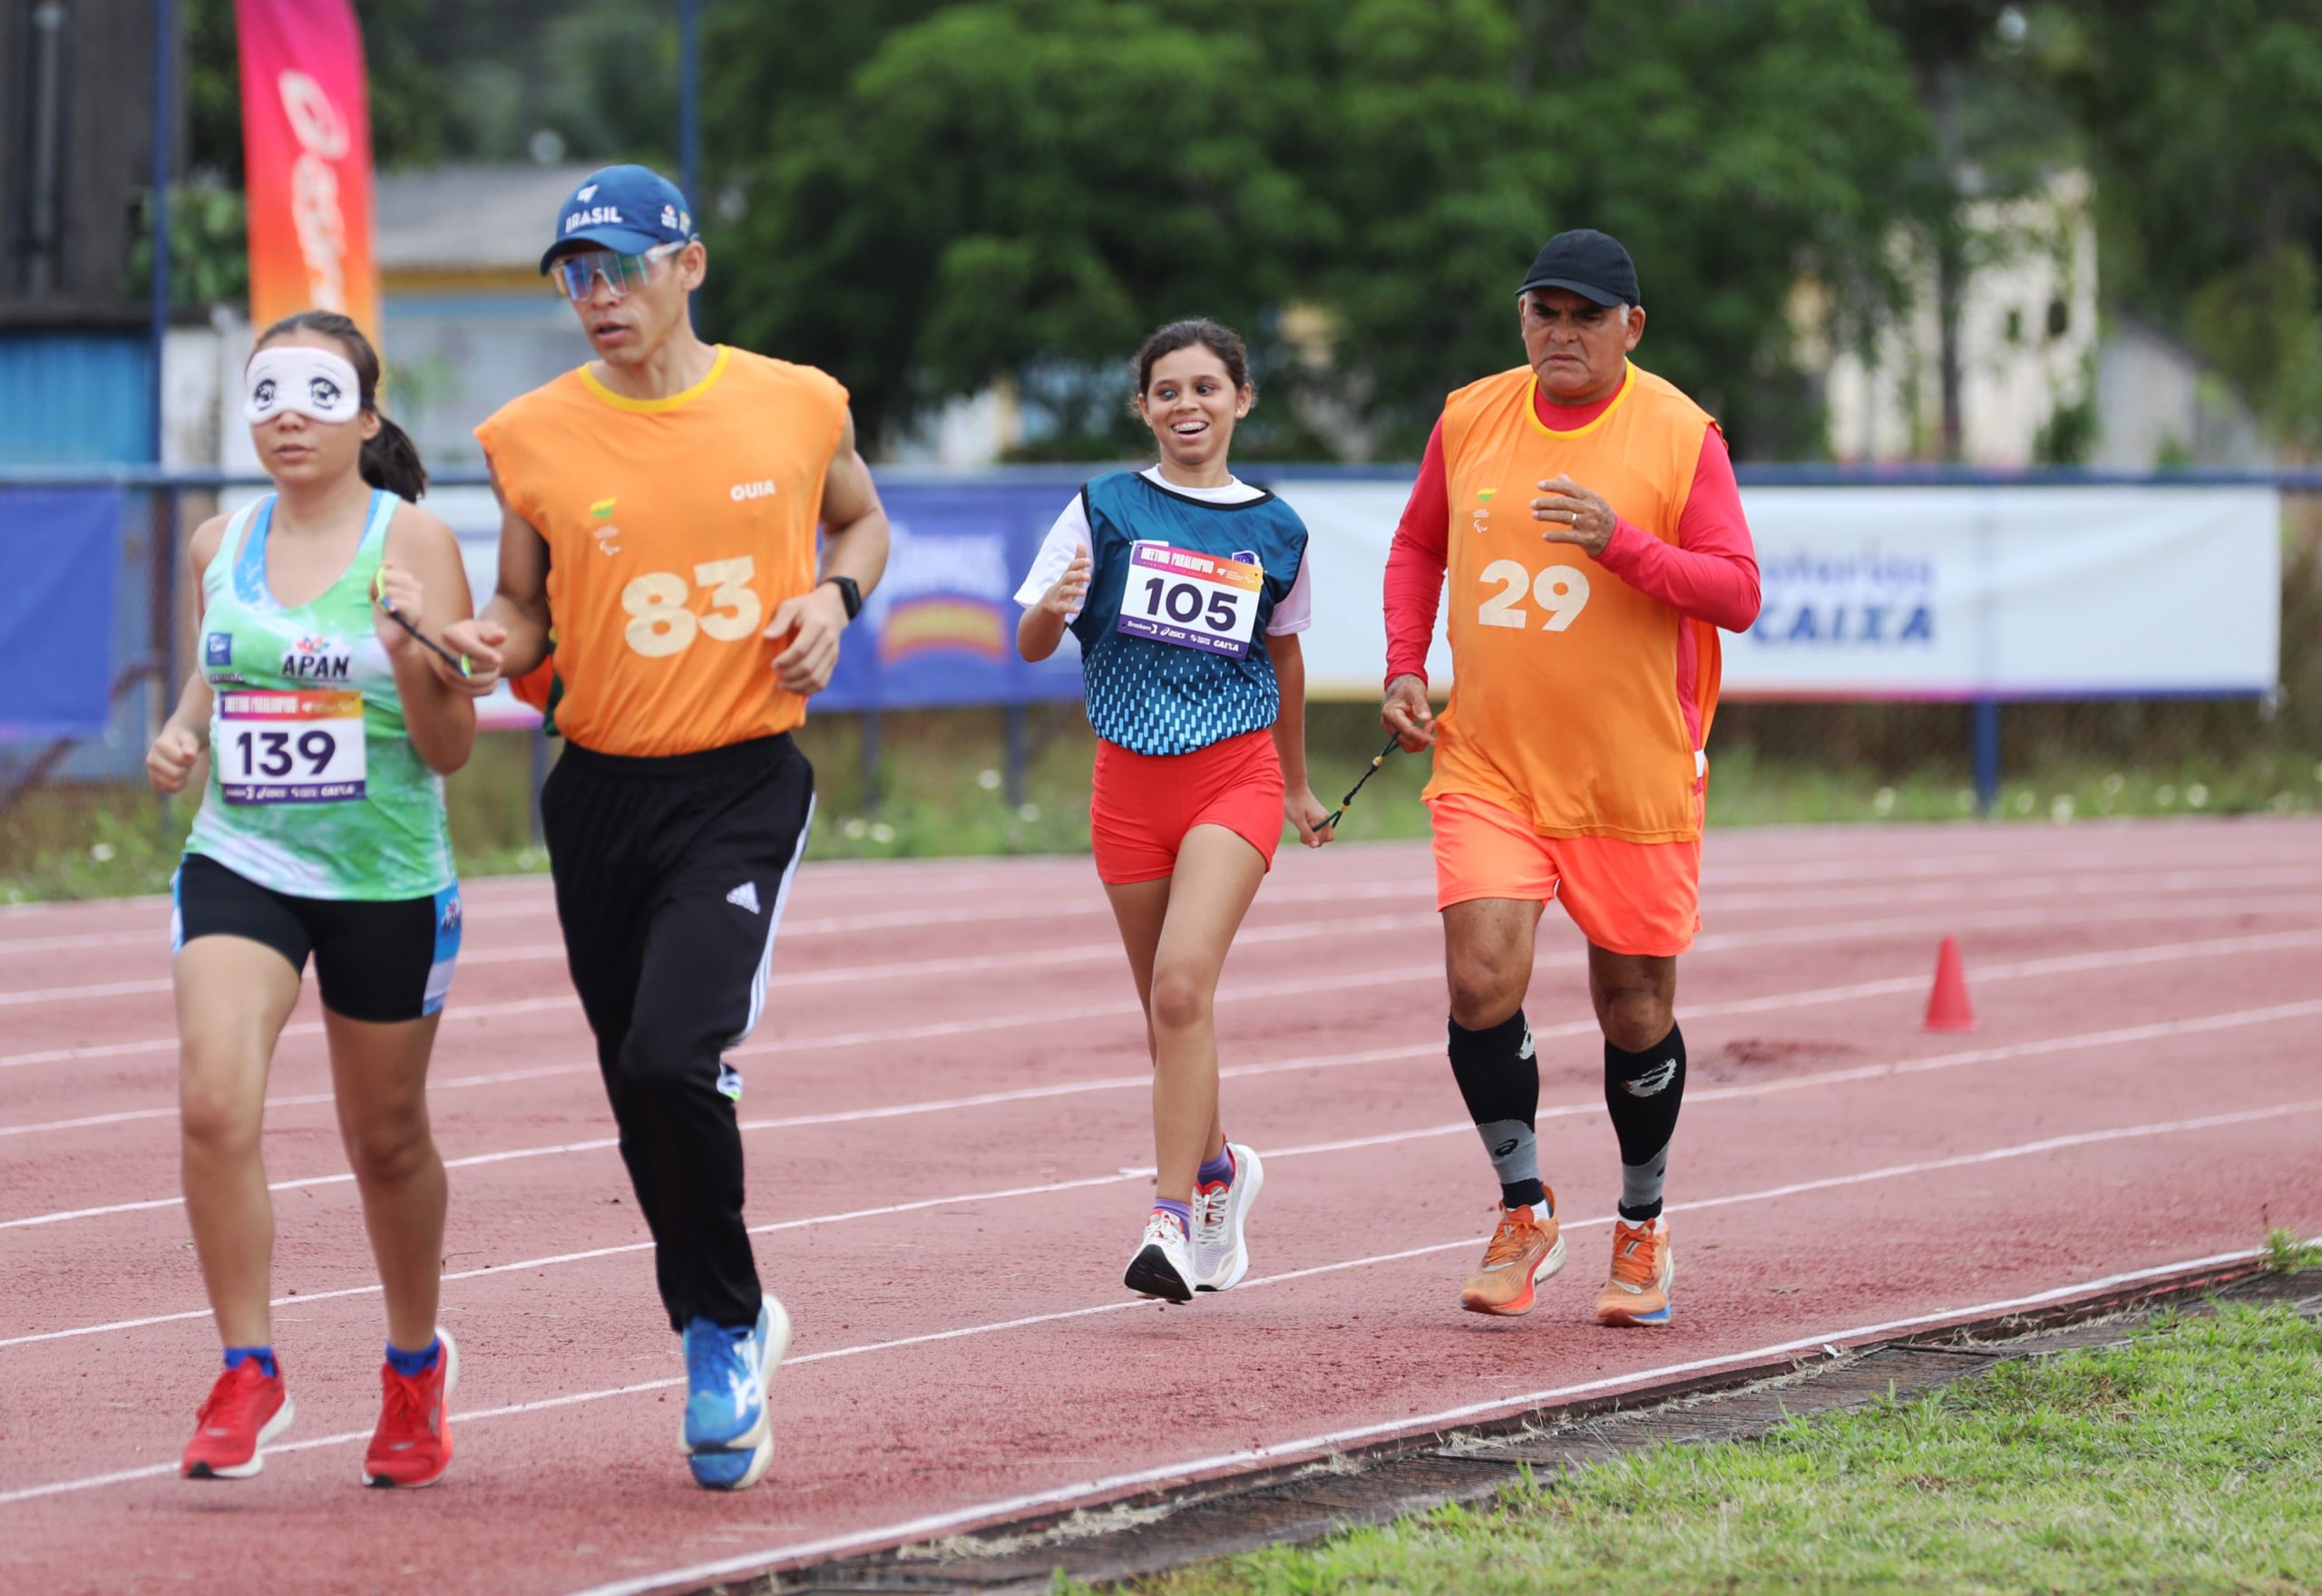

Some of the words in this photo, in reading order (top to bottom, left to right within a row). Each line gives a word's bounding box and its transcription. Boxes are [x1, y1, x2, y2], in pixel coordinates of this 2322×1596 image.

[565, 206, 623, 234] BRASIL
[730, 480, 776, 501] GUIA
[620, 555, 763, 657] 83
[1145, 578, 1238, 632] 105
[1478, 559, 1590, 632] 29
[281, 655, 350, 678] APAN
[237, 731, 336, 777] 139
